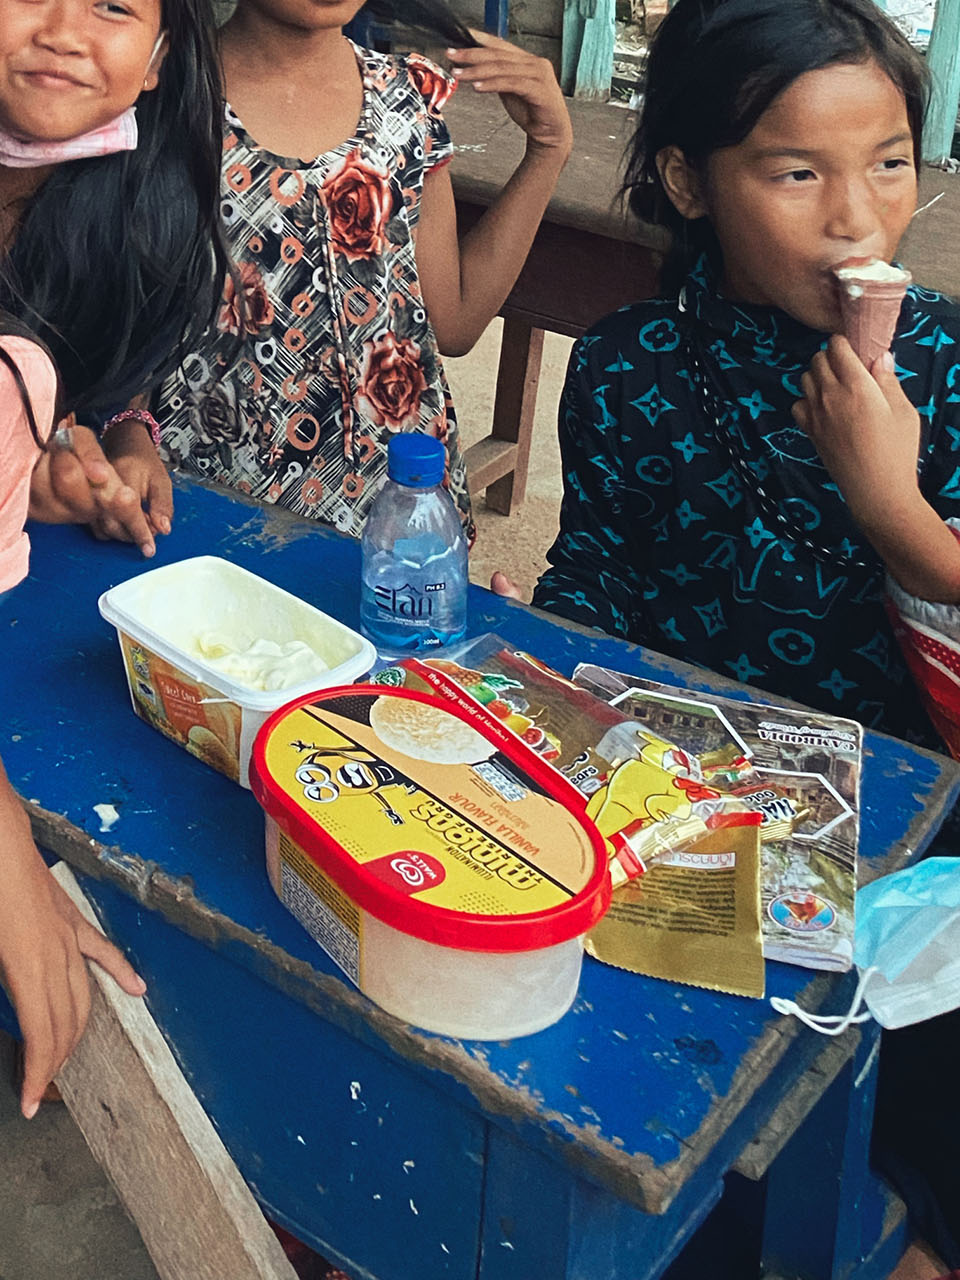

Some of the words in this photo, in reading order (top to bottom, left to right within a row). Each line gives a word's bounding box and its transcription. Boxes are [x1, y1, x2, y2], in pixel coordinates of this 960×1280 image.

[427, 673, 440, 687] the
[440, 683, 458, 702] happy
[458, 696, 477, 715] world
[476, 710, 485, 722] of
[757, 729, 857, 751] CAMBODIA
[570, 765, 598, 787] ears
[426, 800, 454, 819] GRU
[448, 792, 499, 827] FLAVOUR
[456, 821, 474, 834] OF
[477, 836, 512, 860] RISE
[496, 823, 540, 857] VANILLA
[409, 853, 437, 880] WALL'S
[445, 844, 495, 881] ILLUMINATION
[515, 863, 543, 885] THE
